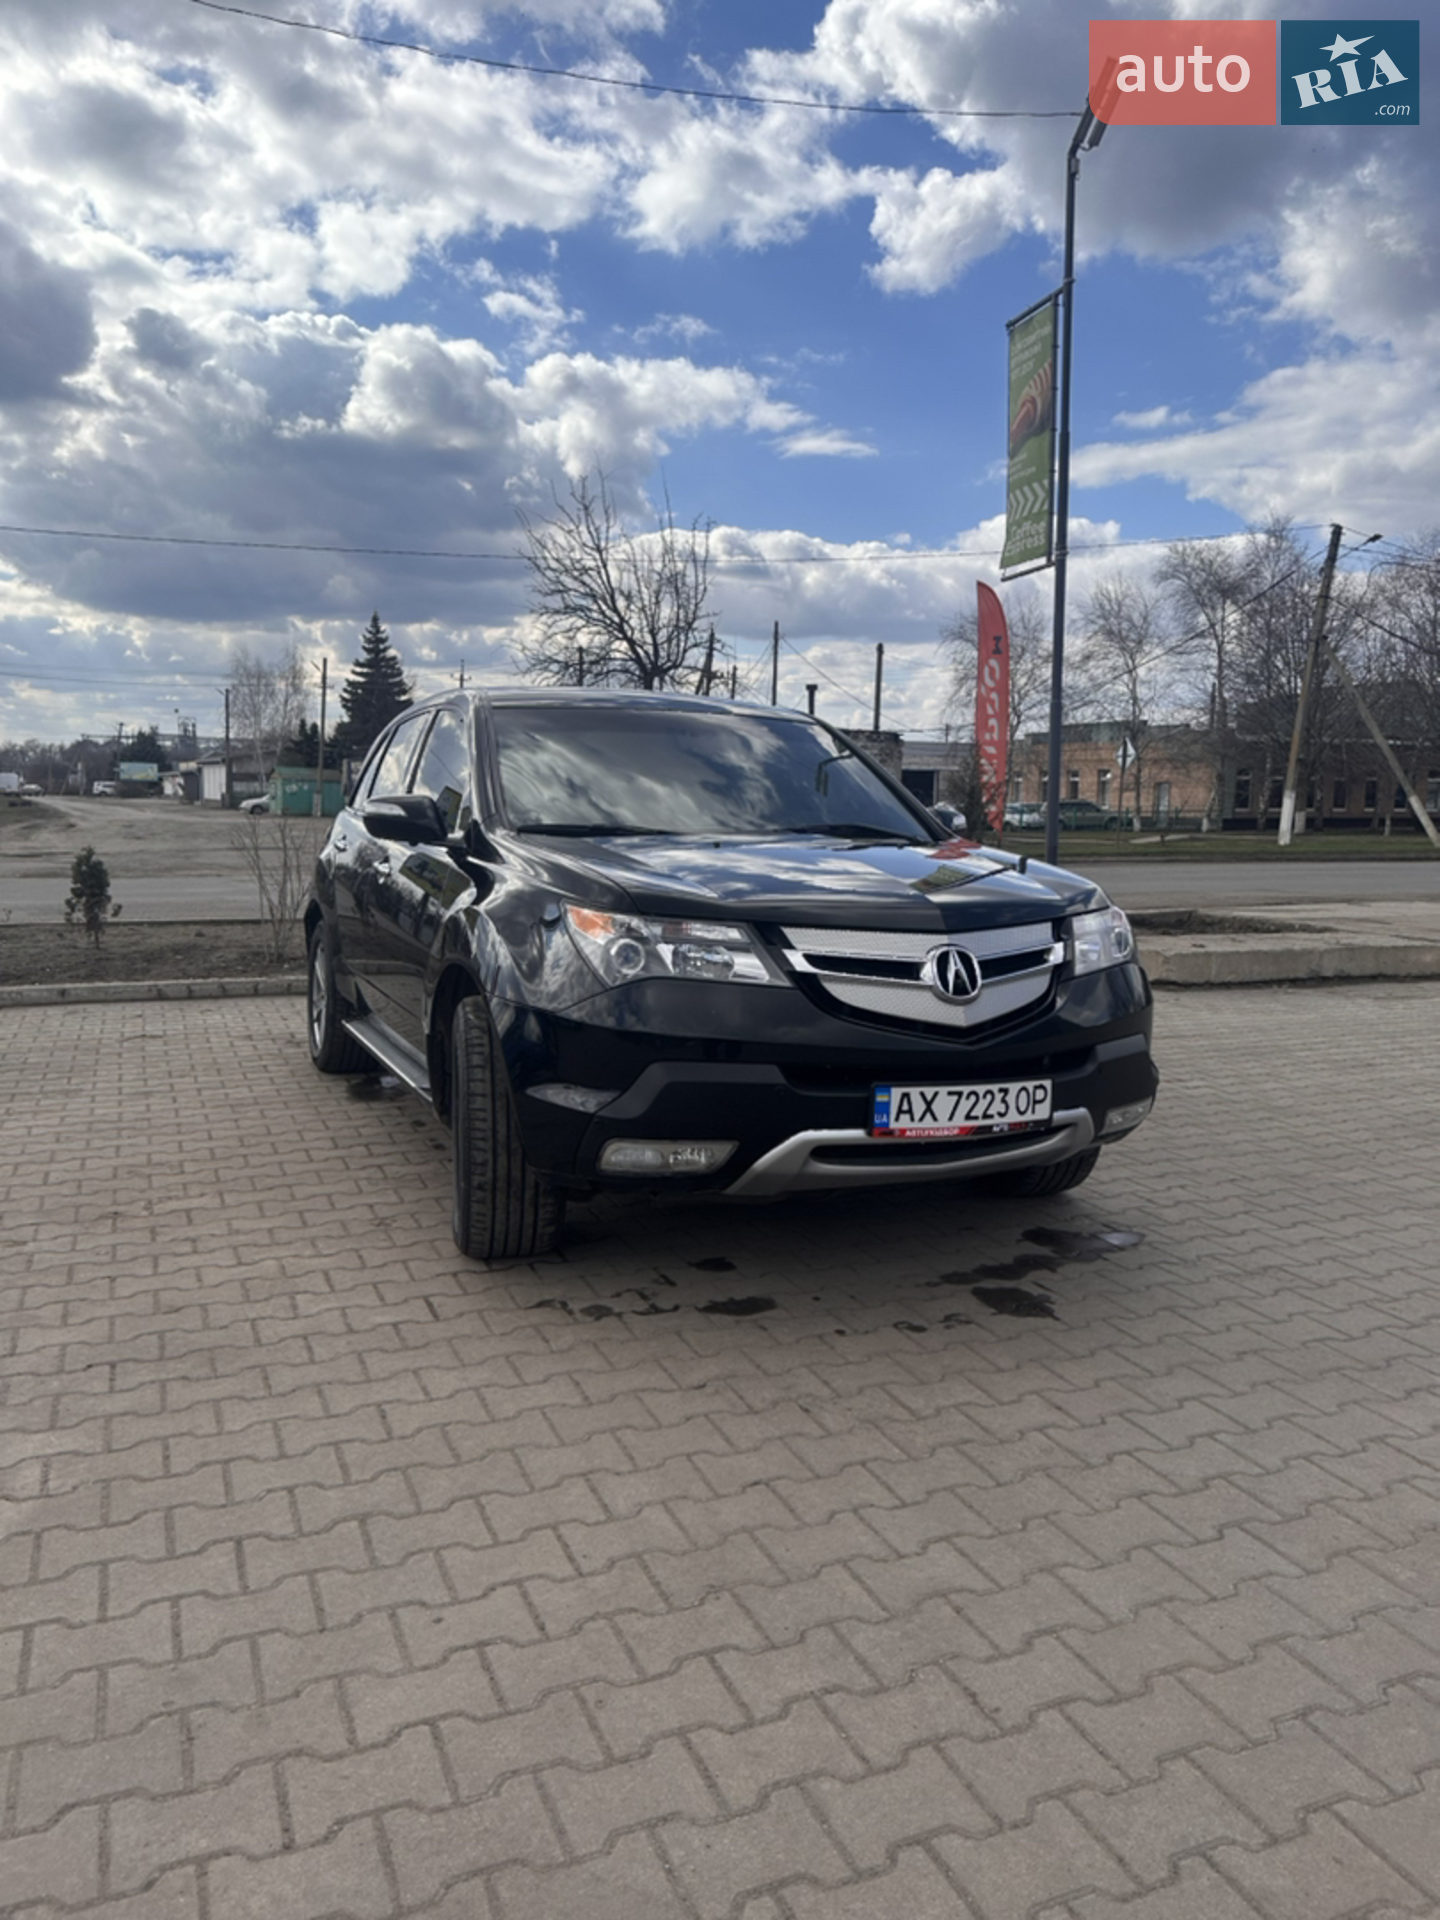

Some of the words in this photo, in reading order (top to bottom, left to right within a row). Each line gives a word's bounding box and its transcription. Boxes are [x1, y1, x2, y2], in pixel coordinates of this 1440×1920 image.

[1011, 520, 1046, 542] Coffee
[894, 1090, 939, 1123] AX
[946, 1087, 1010, 1122] 7223
[1015, 1083, 1048, 1116] OP
[874, 1113, 888, 1124] UA
